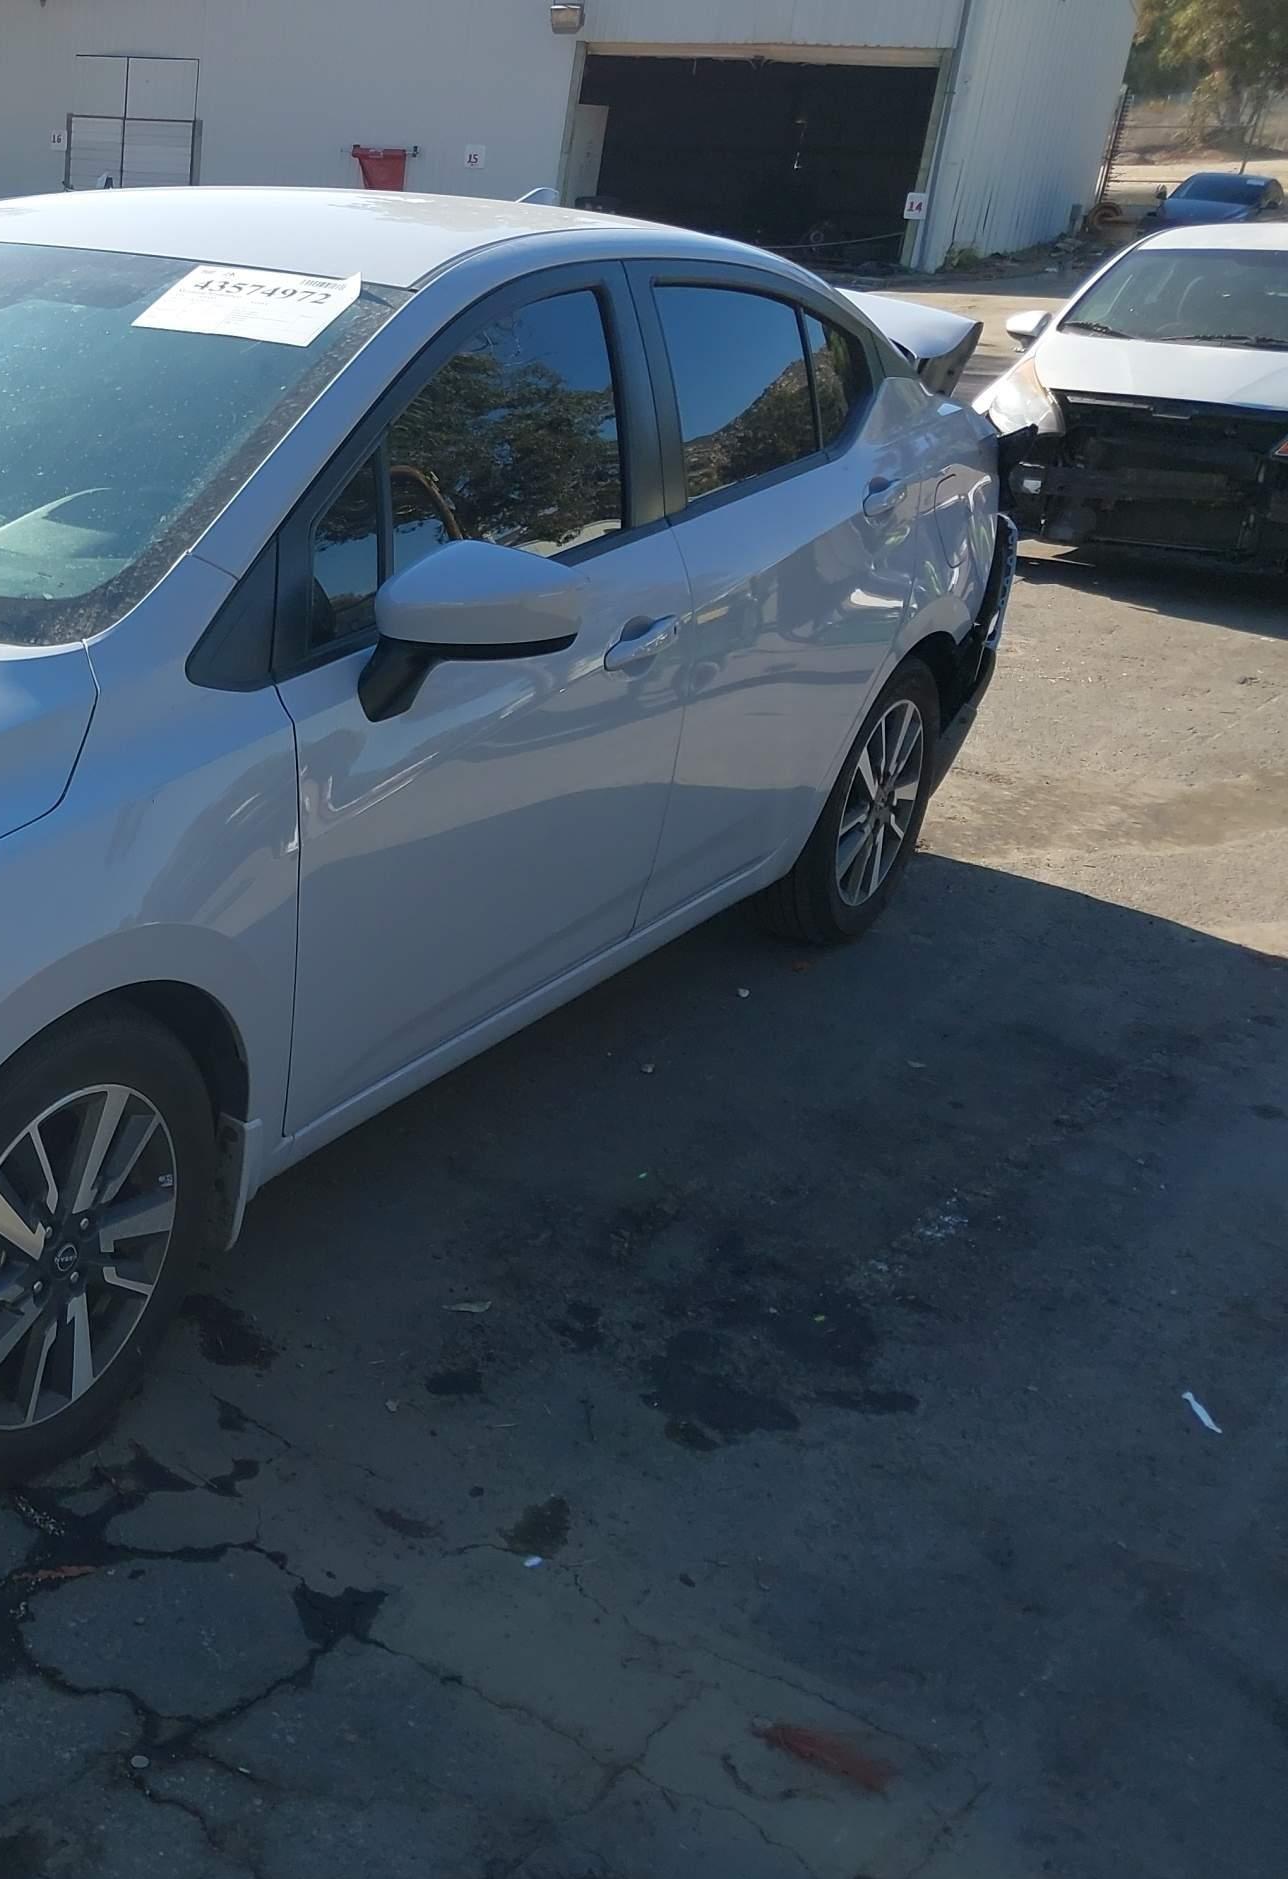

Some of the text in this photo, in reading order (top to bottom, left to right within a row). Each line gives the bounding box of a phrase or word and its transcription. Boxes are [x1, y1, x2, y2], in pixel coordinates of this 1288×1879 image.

[52, 134, 62, 144] 16
[467, 153, 479, 164] 15
[906, 201, 923, 213] 14
[193, 279, 332, 305] 43574972
